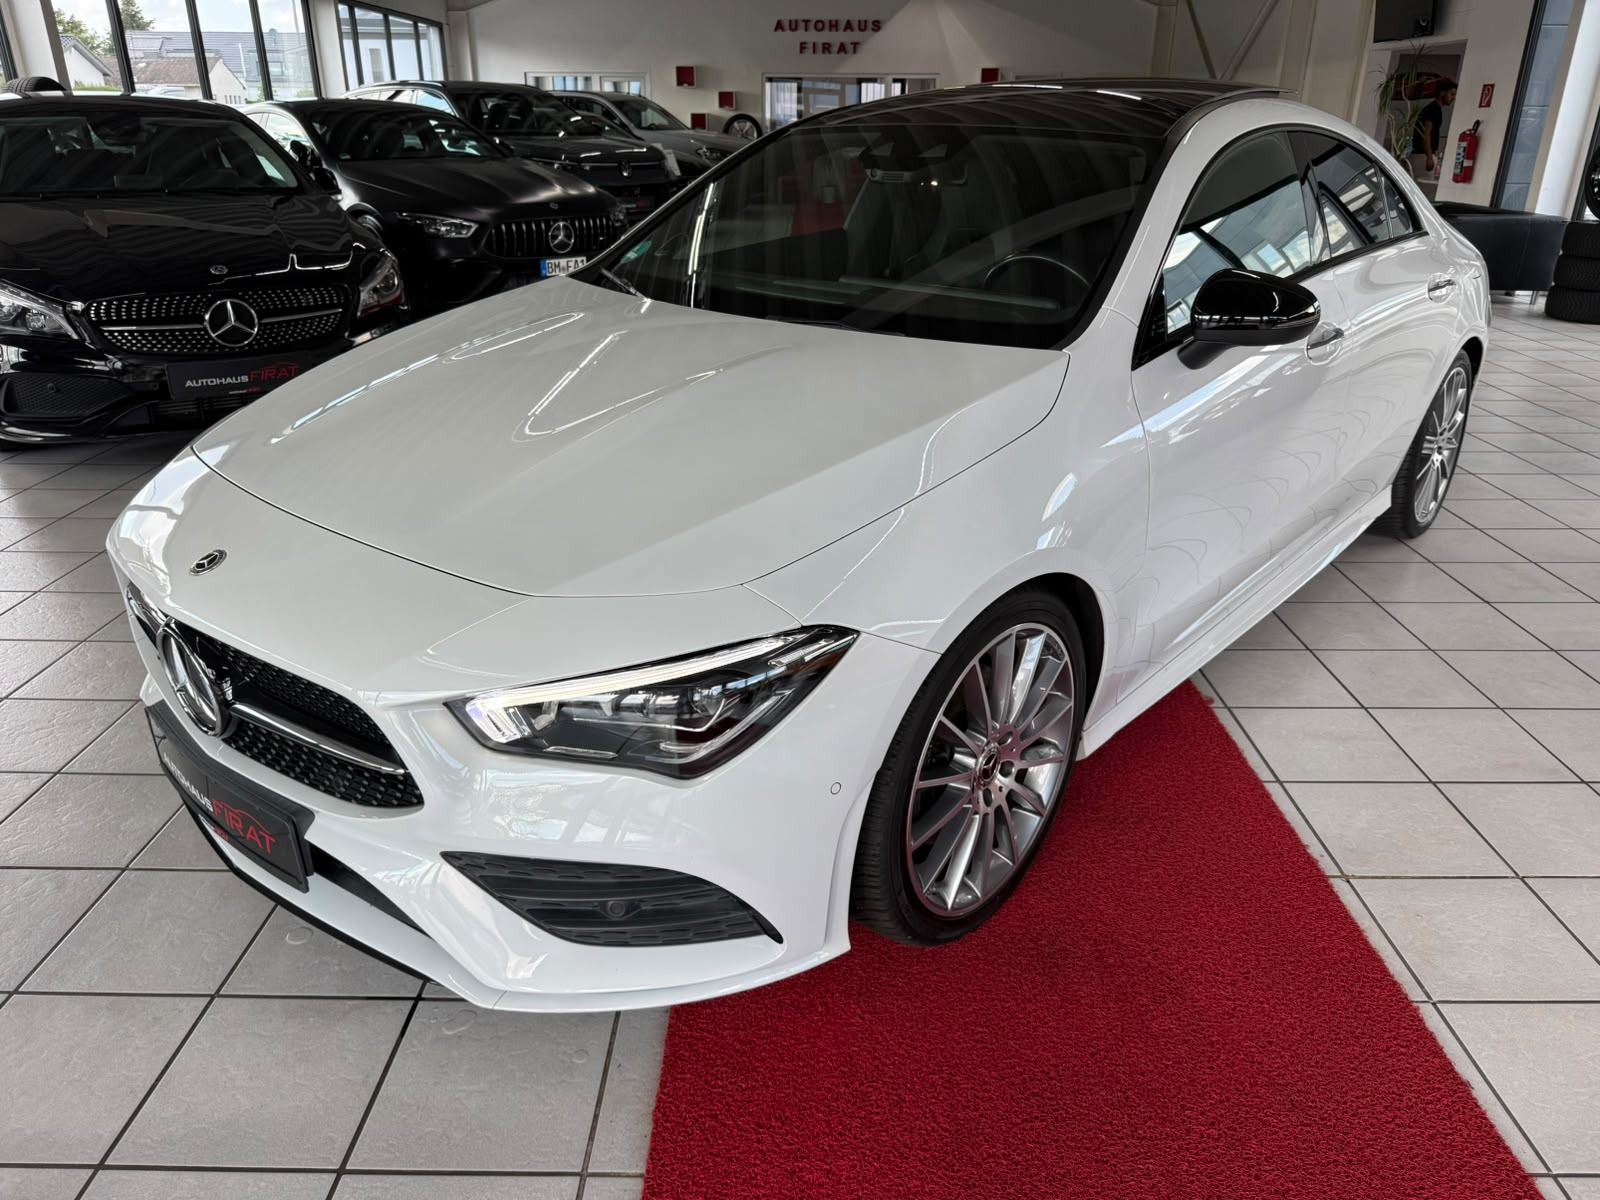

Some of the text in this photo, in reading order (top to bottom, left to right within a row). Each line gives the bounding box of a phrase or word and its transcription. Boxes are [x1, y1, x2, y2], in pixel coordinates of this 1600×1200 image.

[774, 19, 882, 32] AUTOHAUS
[799, 41, 861, 54] FIRAT
[547, 261, 560, 274] BM
[185, 364, 299, 388] AUTOHAUS FIRAT
[212, 799, 276, 854] FIRAT
